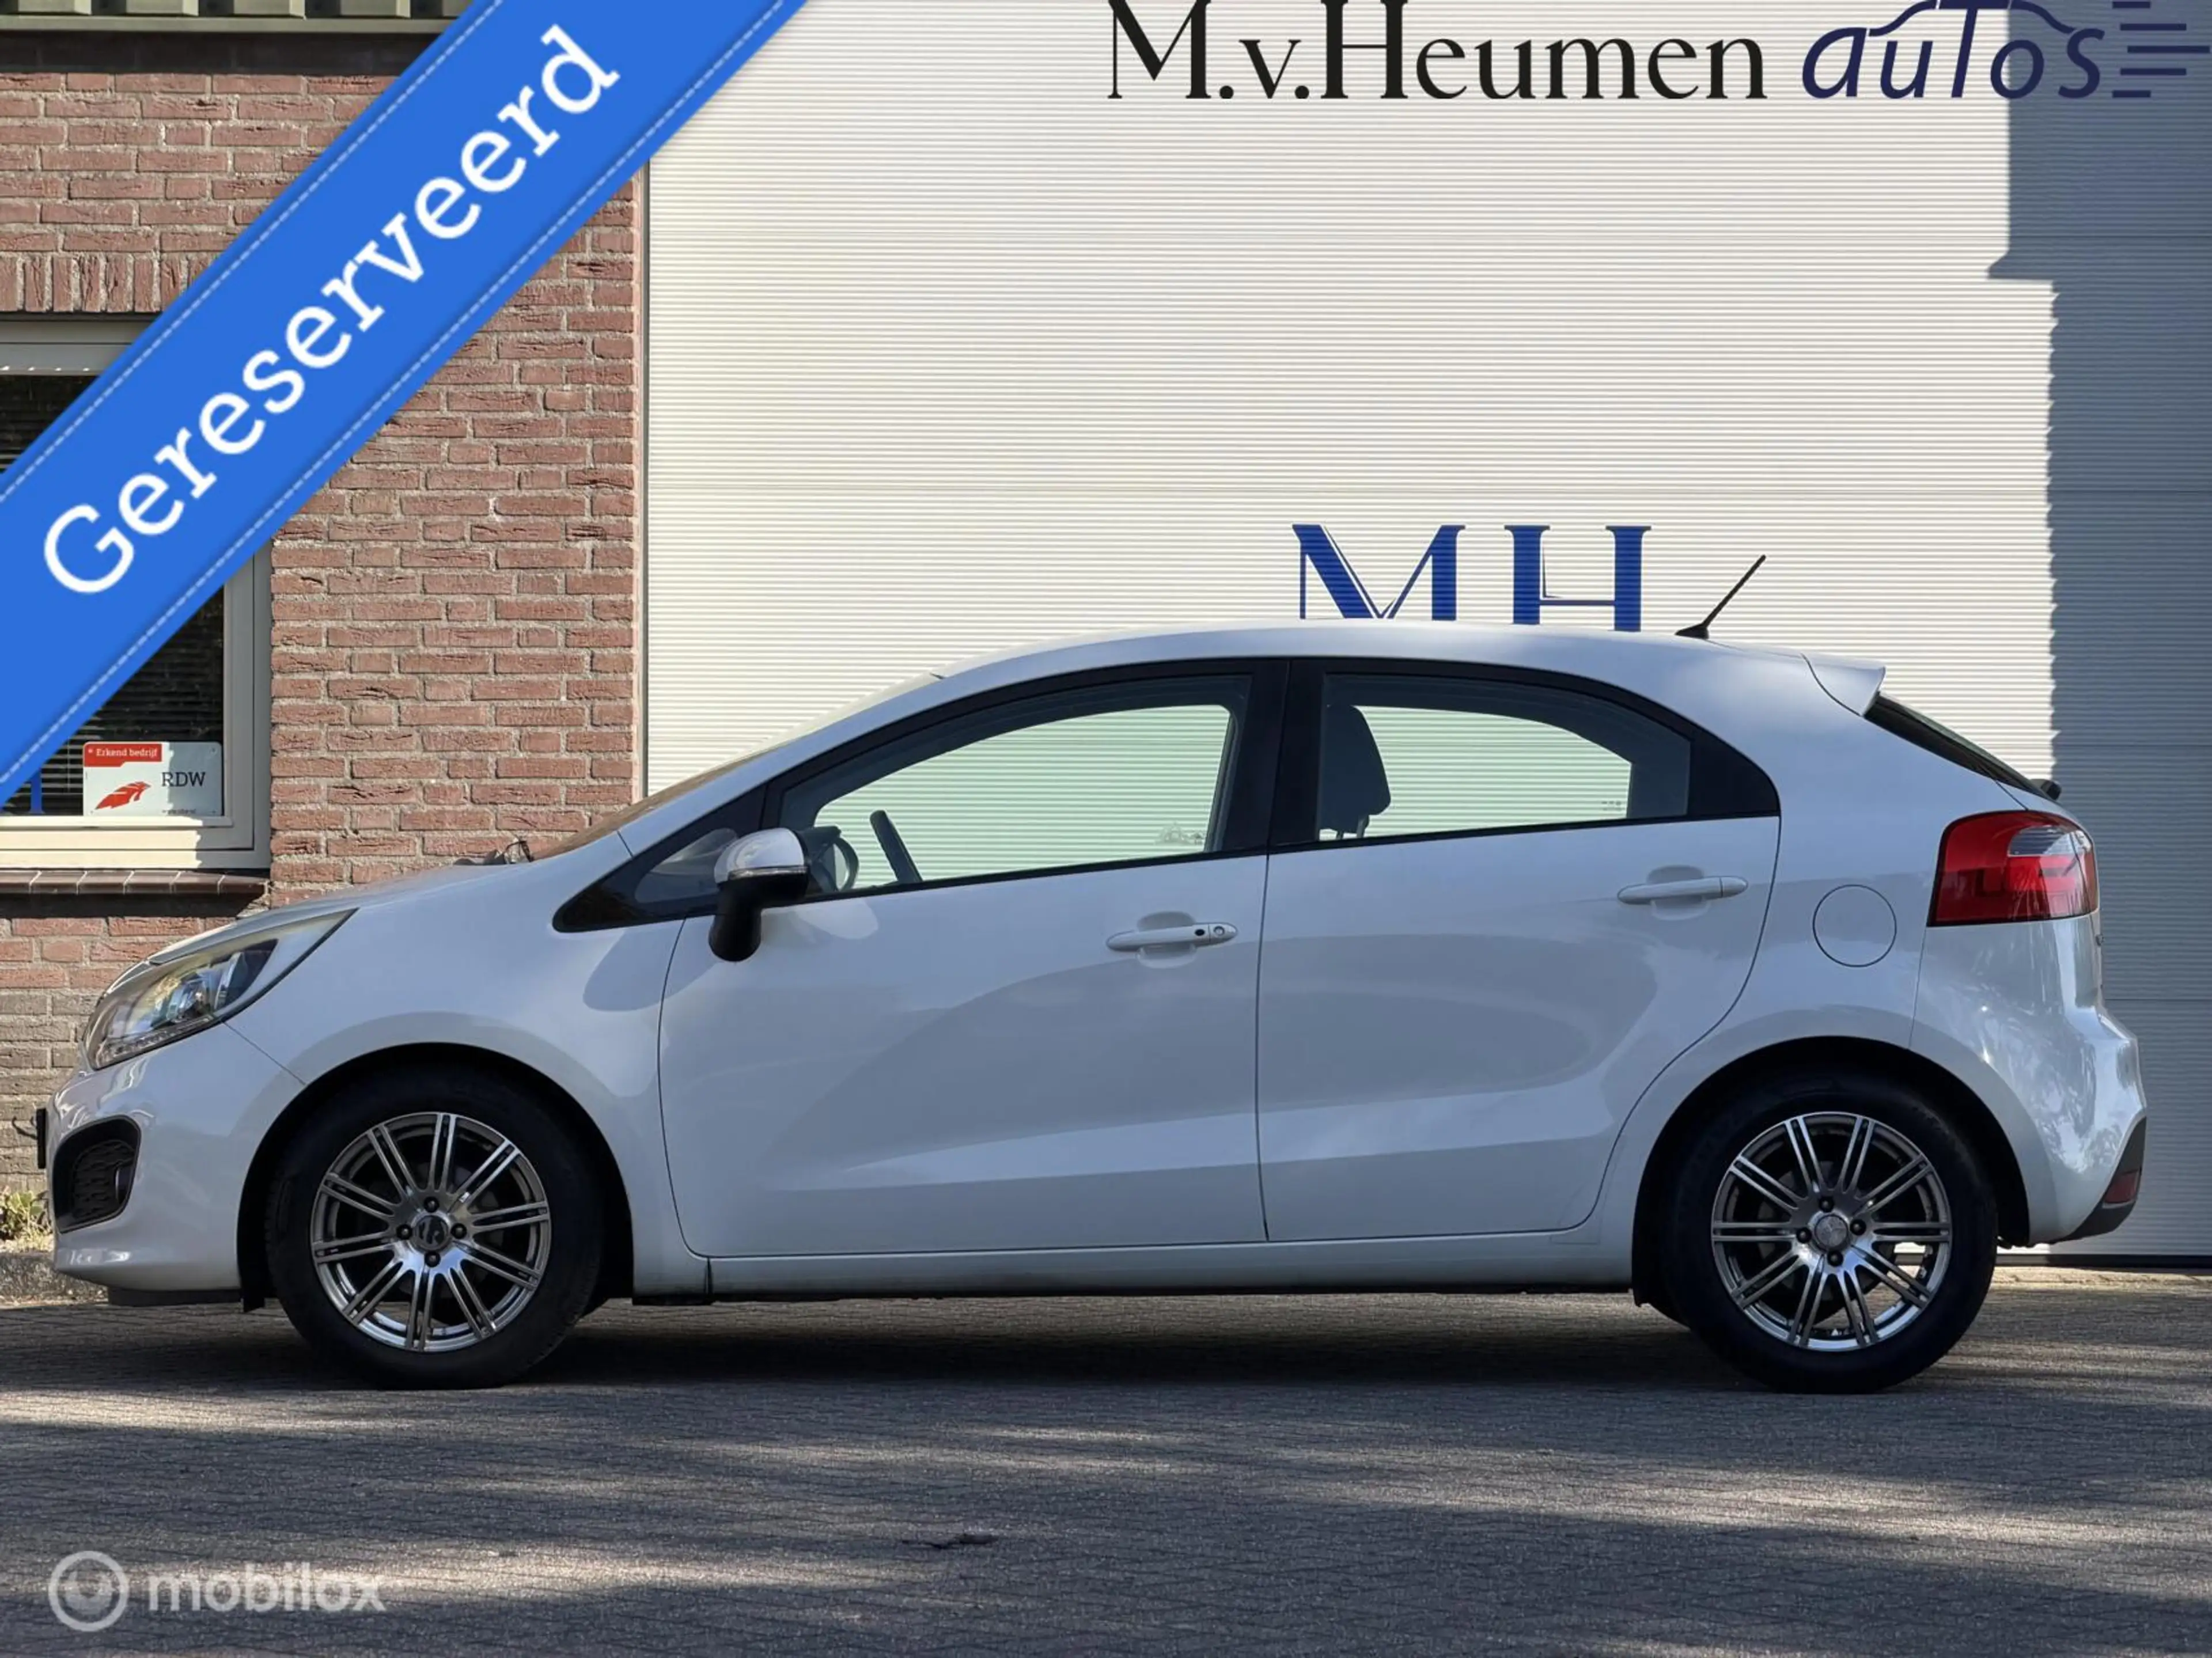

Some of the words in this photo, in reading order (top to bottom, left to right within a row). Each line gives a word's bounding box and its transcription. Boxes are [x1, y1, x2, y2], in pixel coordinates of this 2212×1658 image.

[1292, 524, 1652, 632] MH
[96, 748, 127, 756] Erkend
[129, 748, 158, 758] bedrijf
[162, 772, 206, 787] RDW
